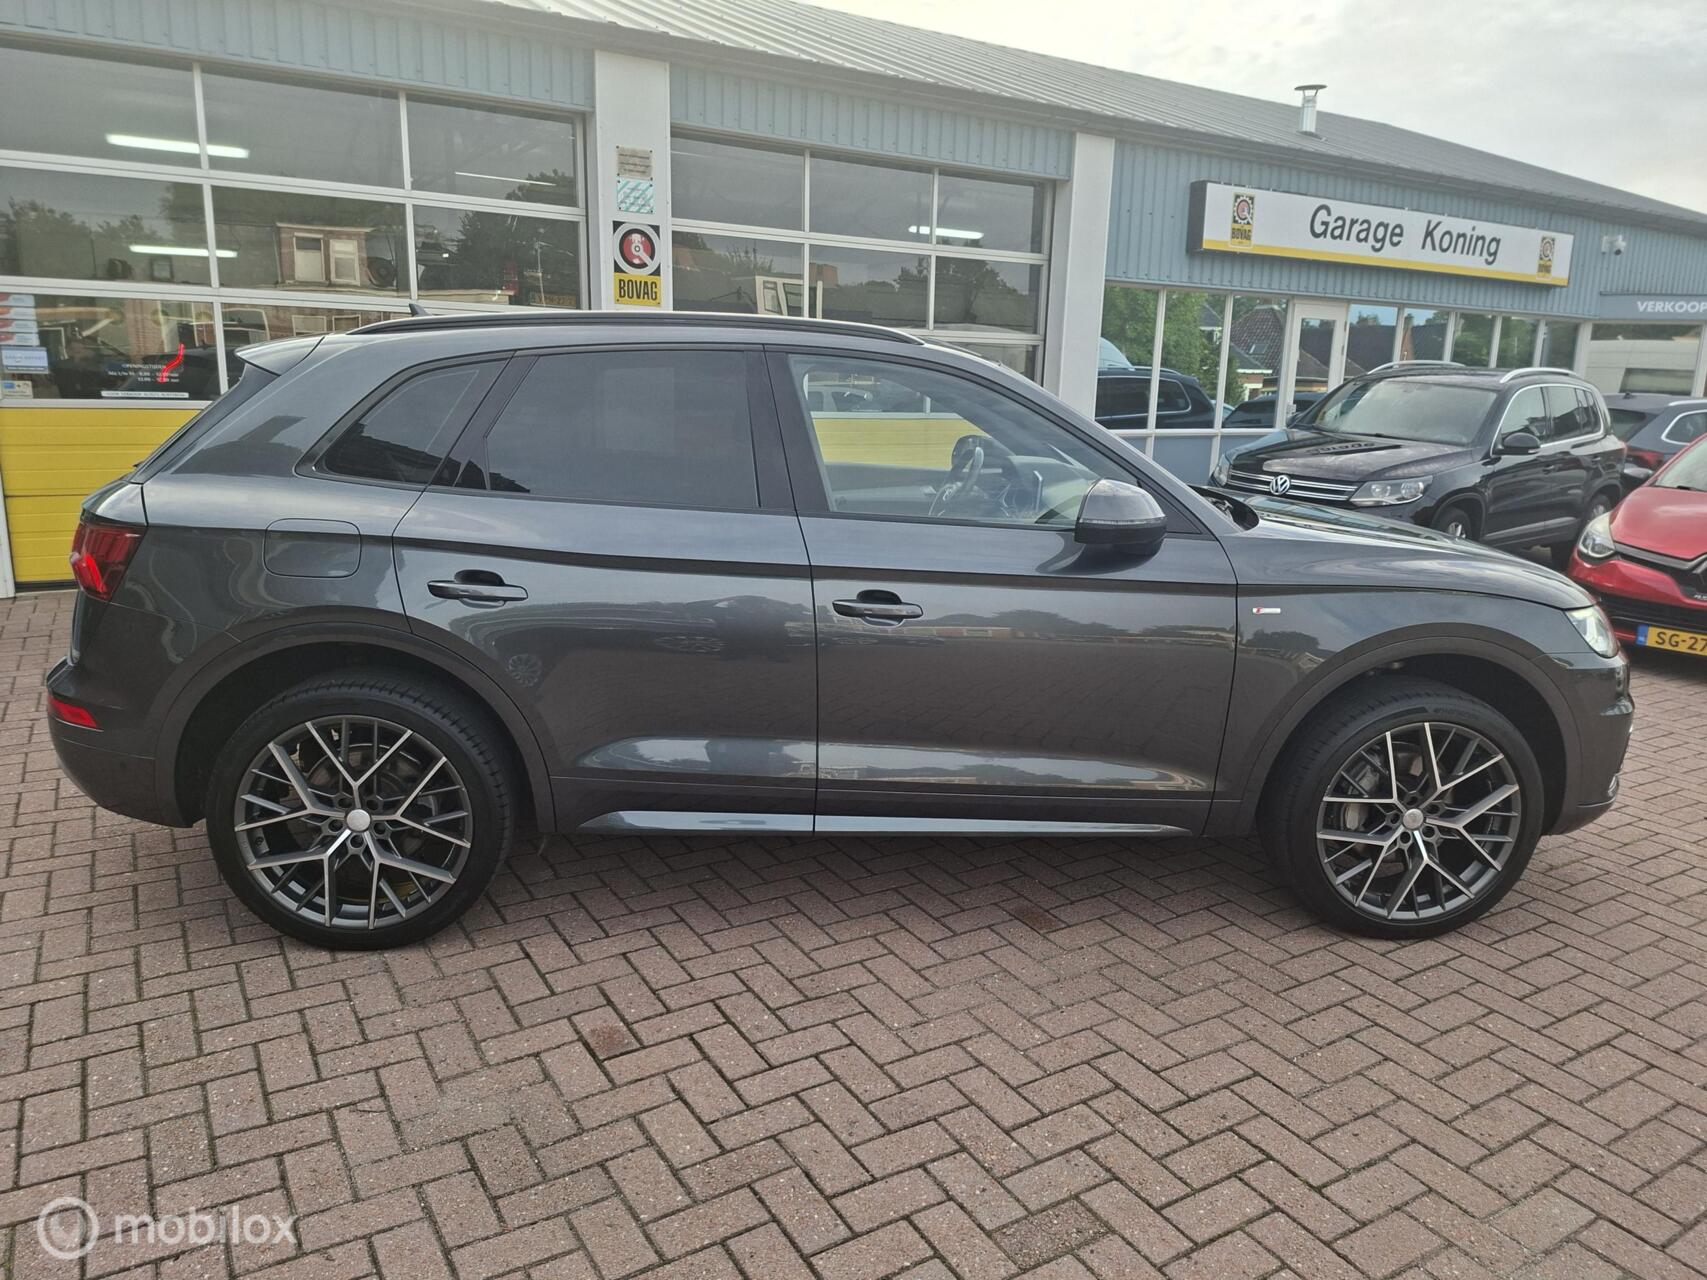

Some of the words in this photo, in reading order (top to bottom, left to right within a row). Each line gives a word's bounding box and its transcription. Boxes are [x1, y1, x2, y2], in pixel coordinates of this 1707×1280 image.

[1310, 204, 1404, 253] Garage
[1421, 219, 1501, 266] Koning
[618, 278, 658, 301] BOVAG
[1636, 300, 1707, 313] VERKOOP
[1655, 630, 1707, 652] SG-27
